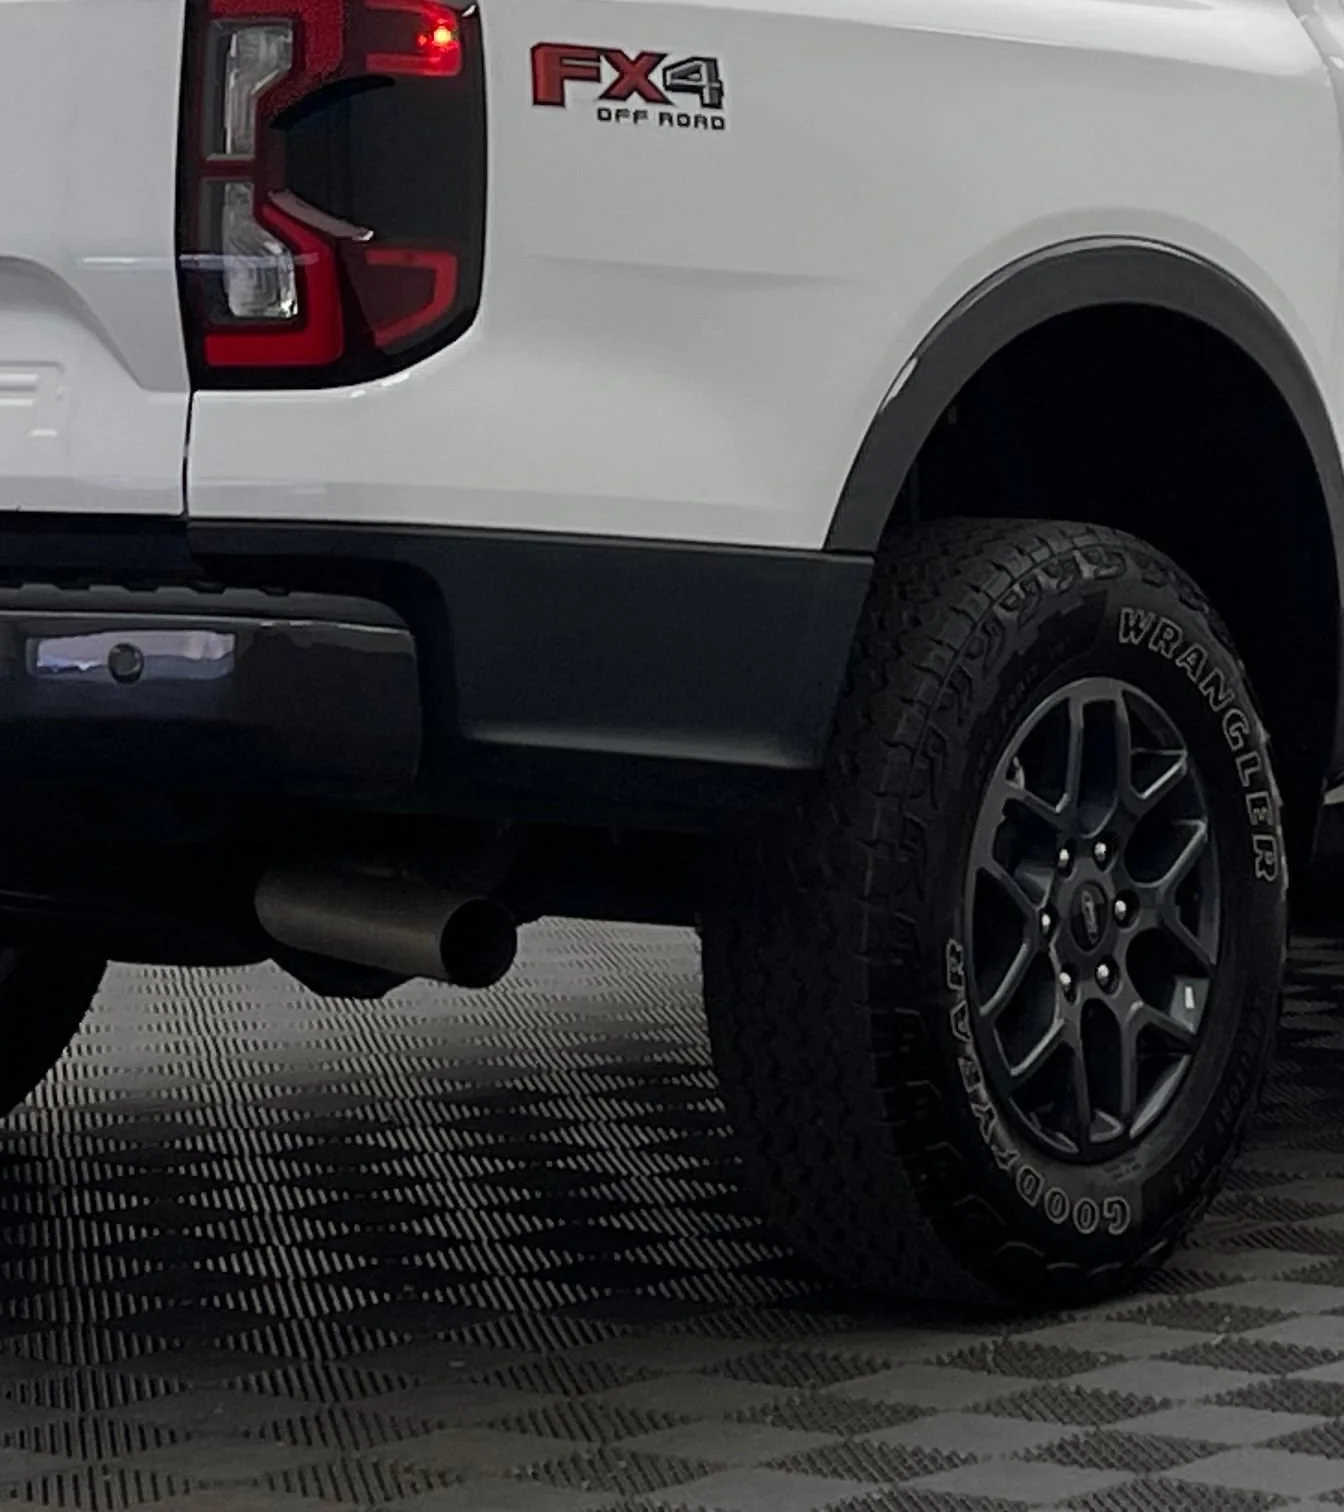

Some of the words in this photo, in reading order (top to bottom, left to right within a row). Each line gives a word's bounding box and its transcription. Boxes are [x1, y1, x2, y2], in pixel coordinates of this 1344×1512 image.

[530, 42, 725, 110] FX4
[597, 107, 649, 125] OFF
[658, 111, 726, 131] ROAD
[1116, 605, 1279, 884] WRANGLER
[945, 937, 1132, 1236] GOODYEAR
